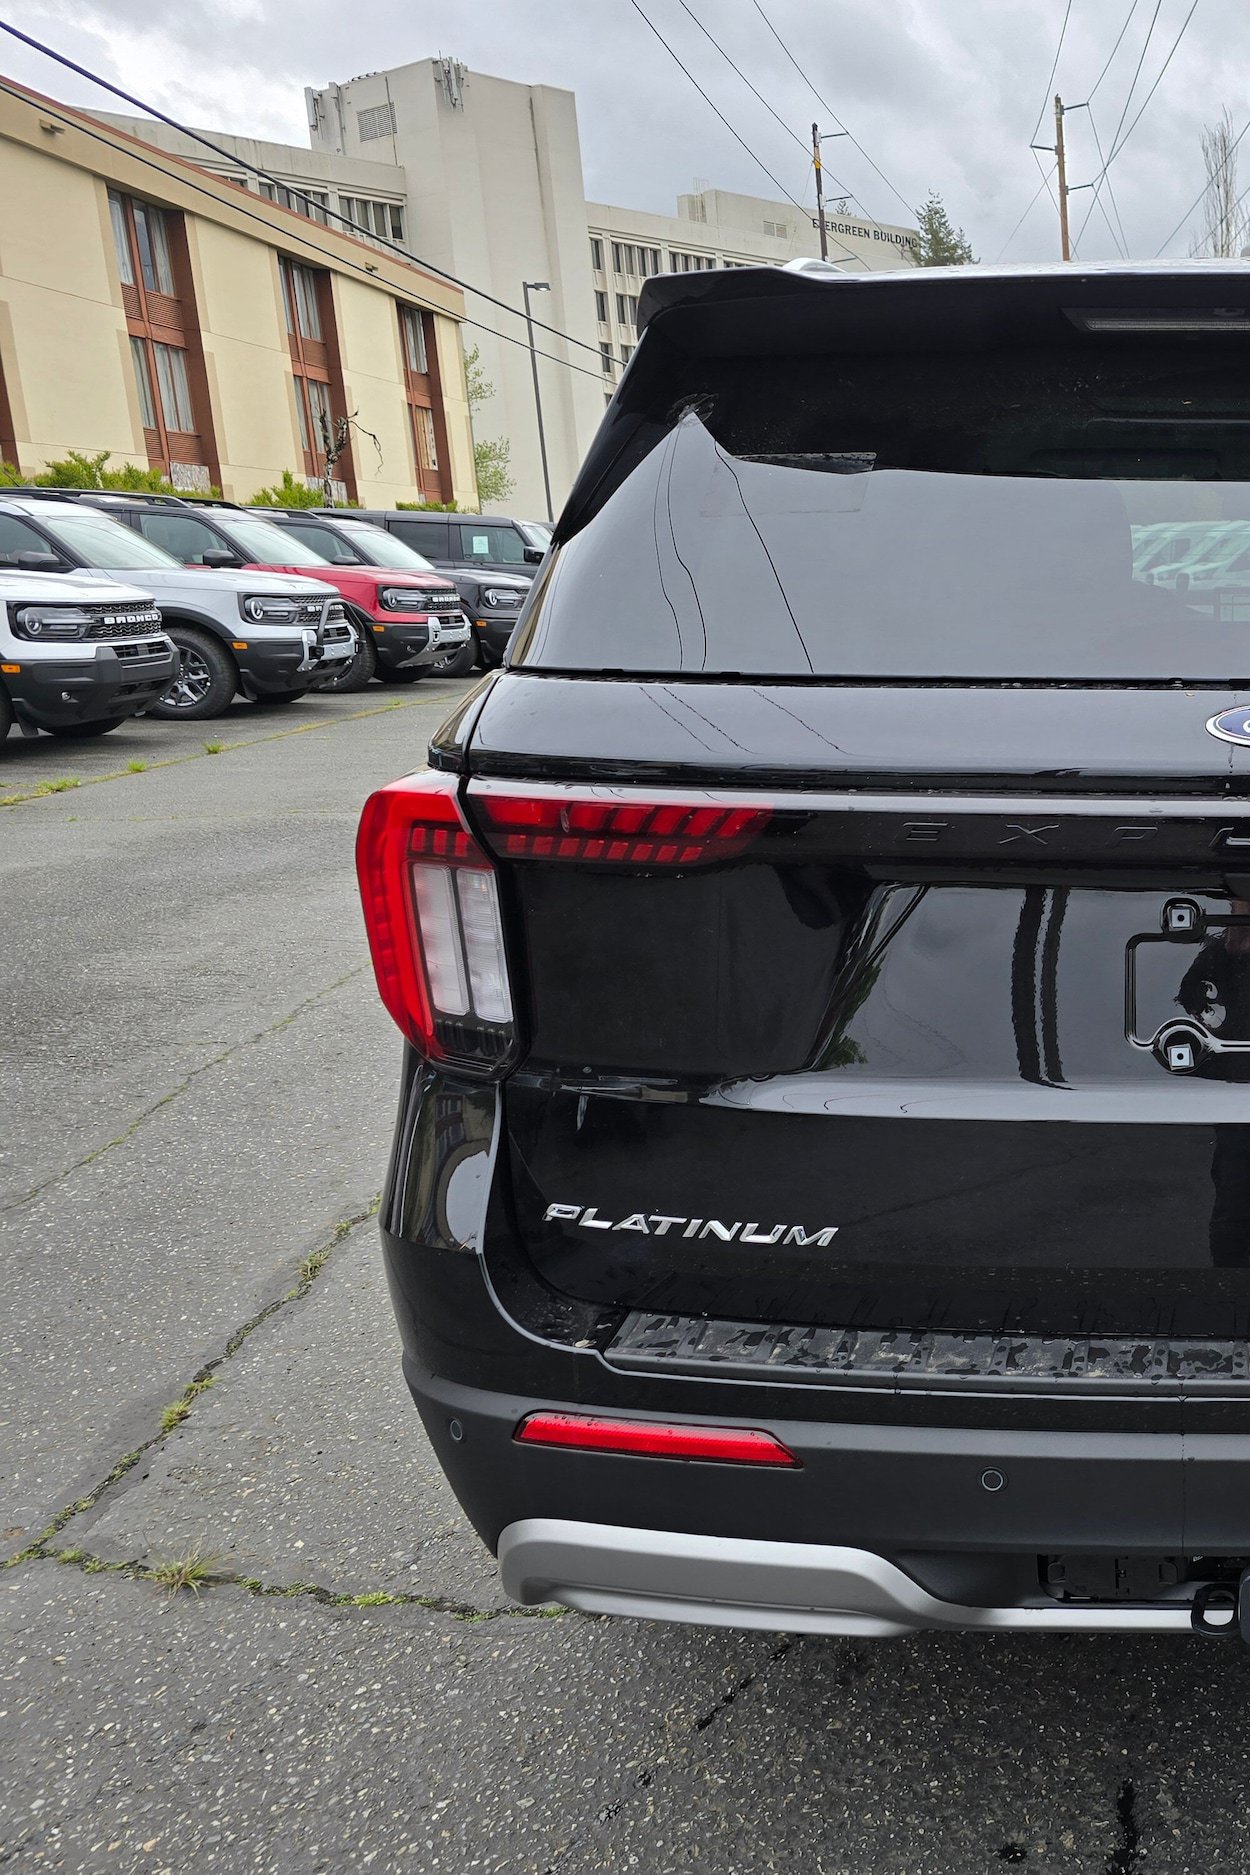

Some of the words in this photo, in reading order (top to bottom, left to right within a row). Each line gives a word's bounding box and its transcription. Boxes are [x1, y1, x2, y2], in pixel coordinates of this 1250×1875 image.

[812, 218, 870, 239] EERGREEN
[873, 230, 918, 248] BUILDING
[104, 613, 159, 624] BRONCO
[542, 1202, 840, 1247] PLATINUM
